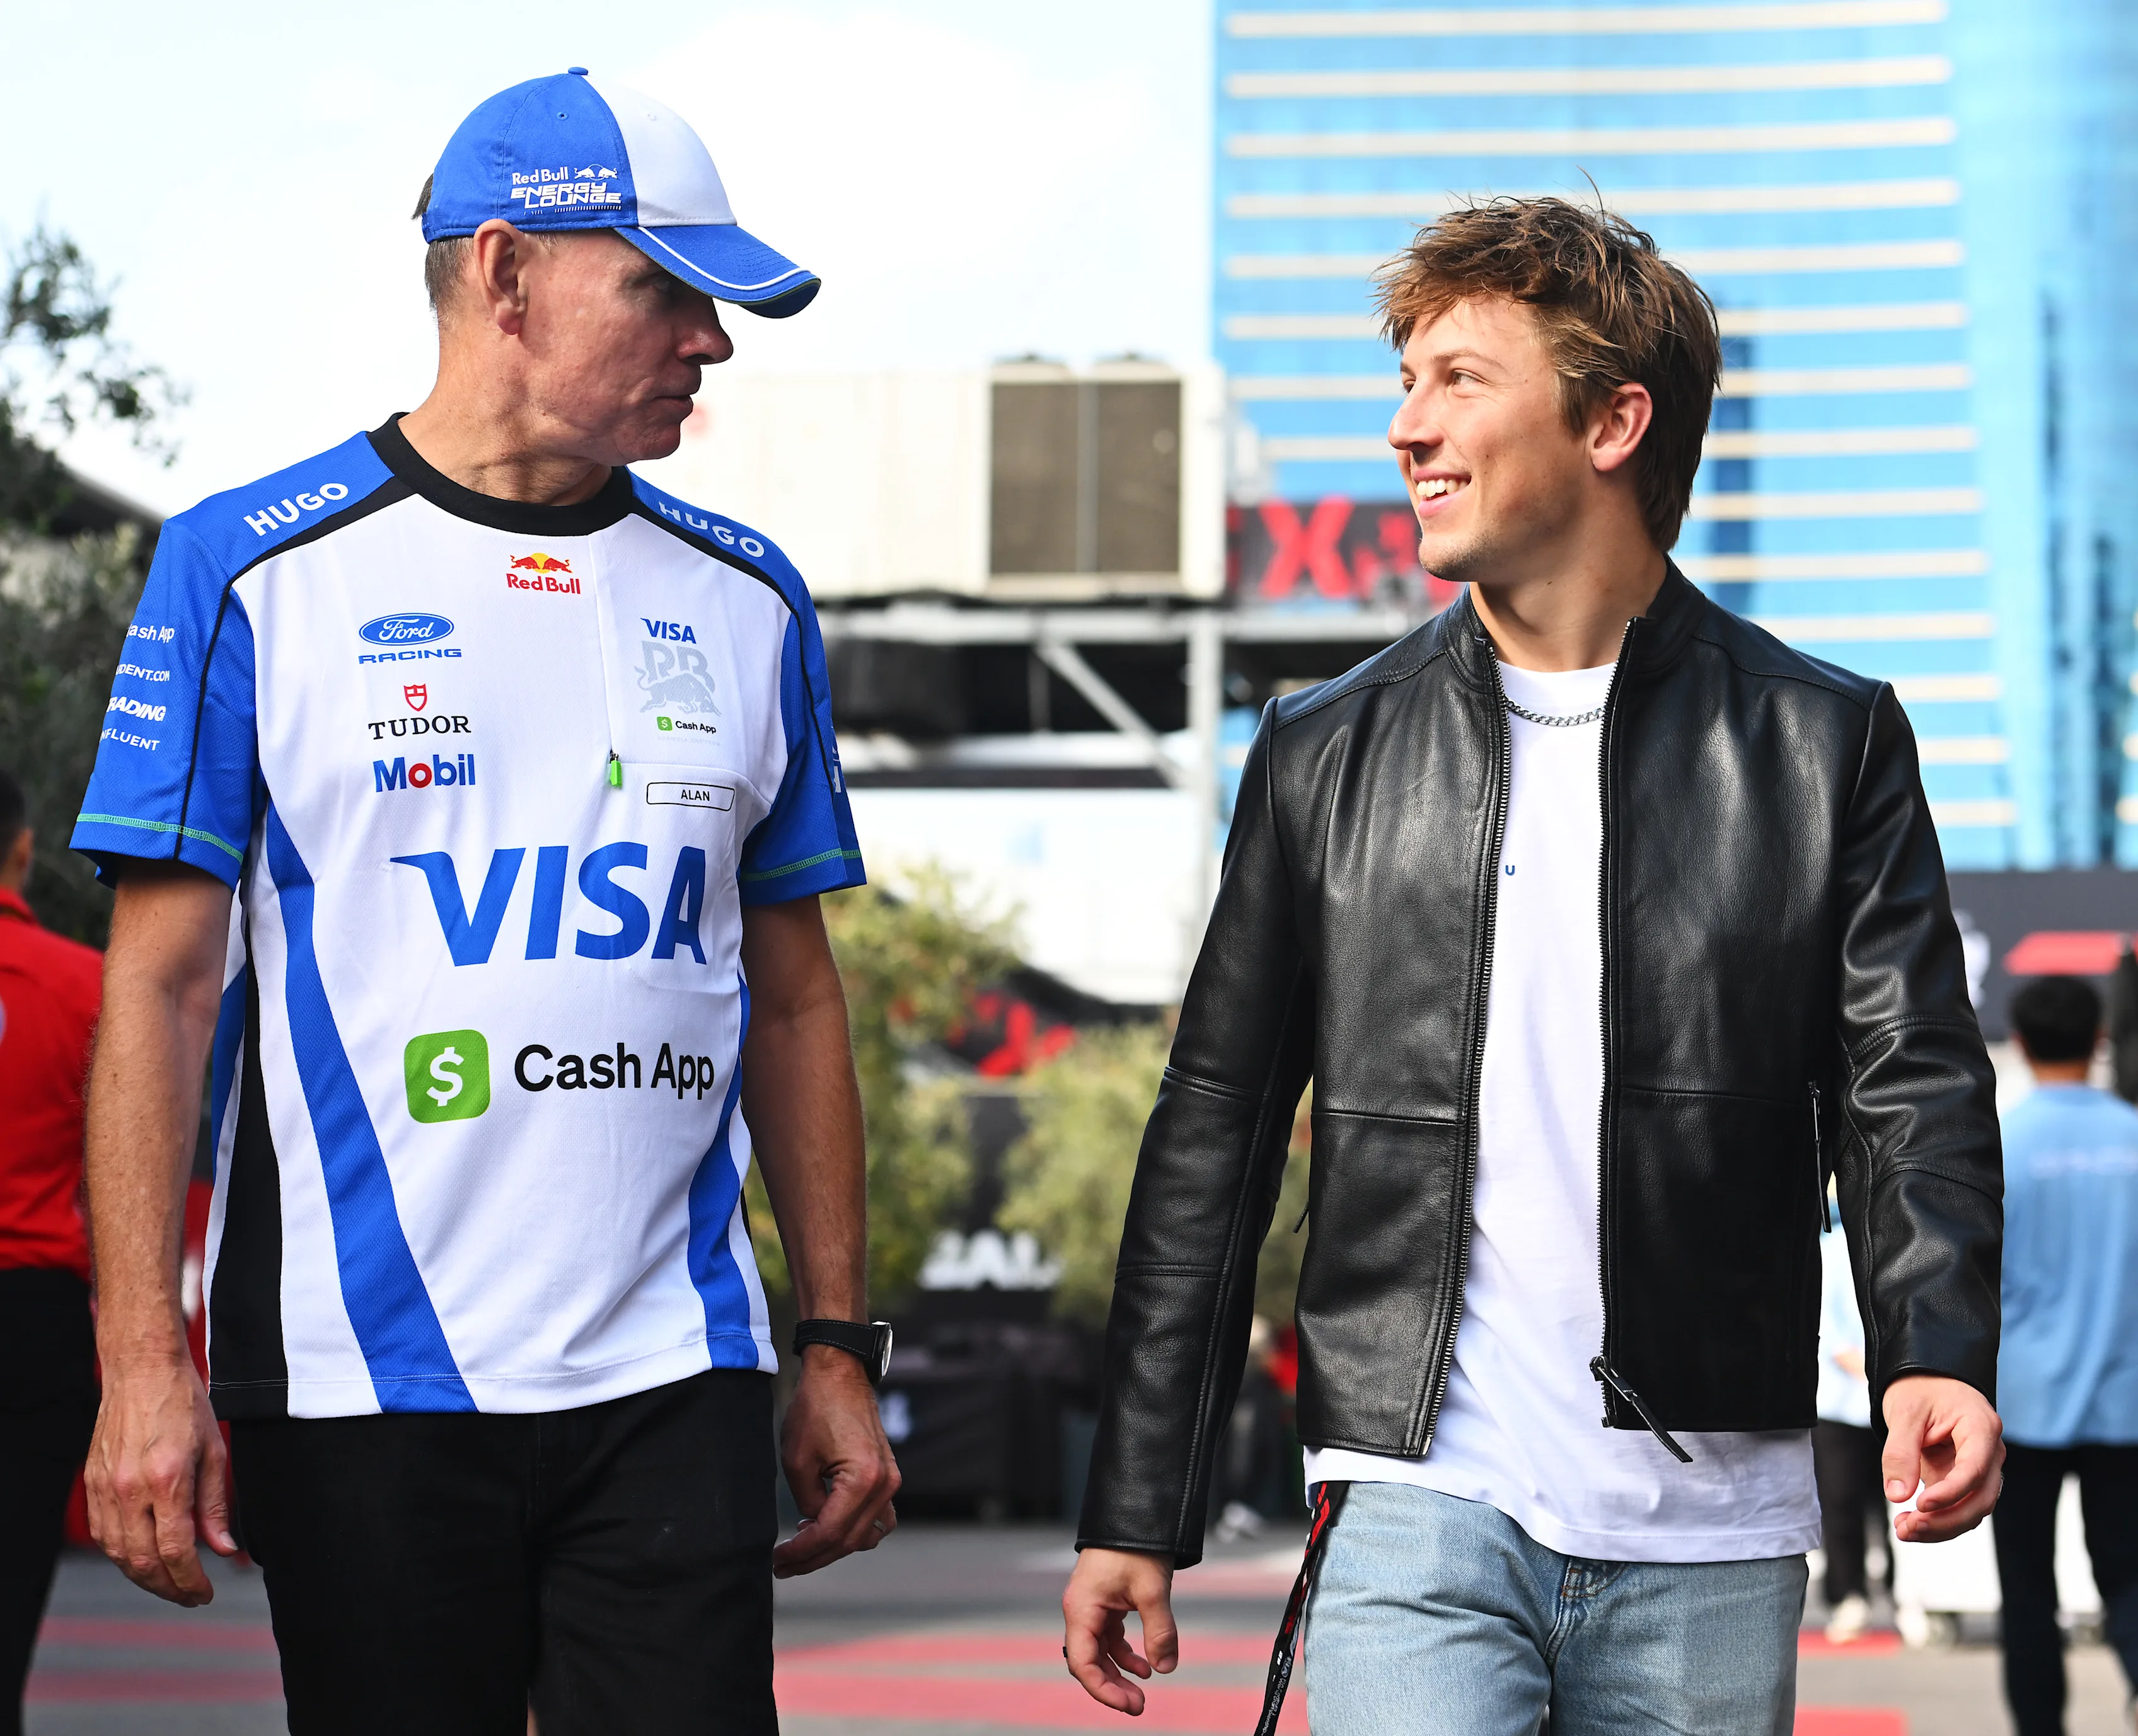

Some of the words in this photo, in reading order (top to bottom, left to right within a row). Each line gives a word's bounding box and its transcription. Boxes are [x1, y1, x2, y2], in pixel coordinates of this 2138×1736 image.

[512, 169, 539, 185] Red
[541, 166, 569, 182] Bull
[511, 182, 606, 199] ENERGY
[524, 191, 621, 209] LOUNGE
[243, 483, 349, 536] HUGO
[659, 502, 765, 558] HUGO
[506, 573, 543, 591] Red
[545, 577, 581, 594] Bull
[126, 624, 157, 641] ash
[158, 626, 175, 643] App
[378, 618, 434, 641] Ford
[640, 618, 696, 644] VISA
[358, 648, 461, 664] RACING
[368, 715, 471, 740] TUDOR
[675, 720, 698, 731] Cash
[700, 723, 717, 734] App
[373, 754, 475, 793] Mobil
[681, 789, 710, 802] ALAN
[390, 841, 707, 967] VISA
[514, 1043, 641, 1092] Cash
[650, 1043, 715, 1100] App
